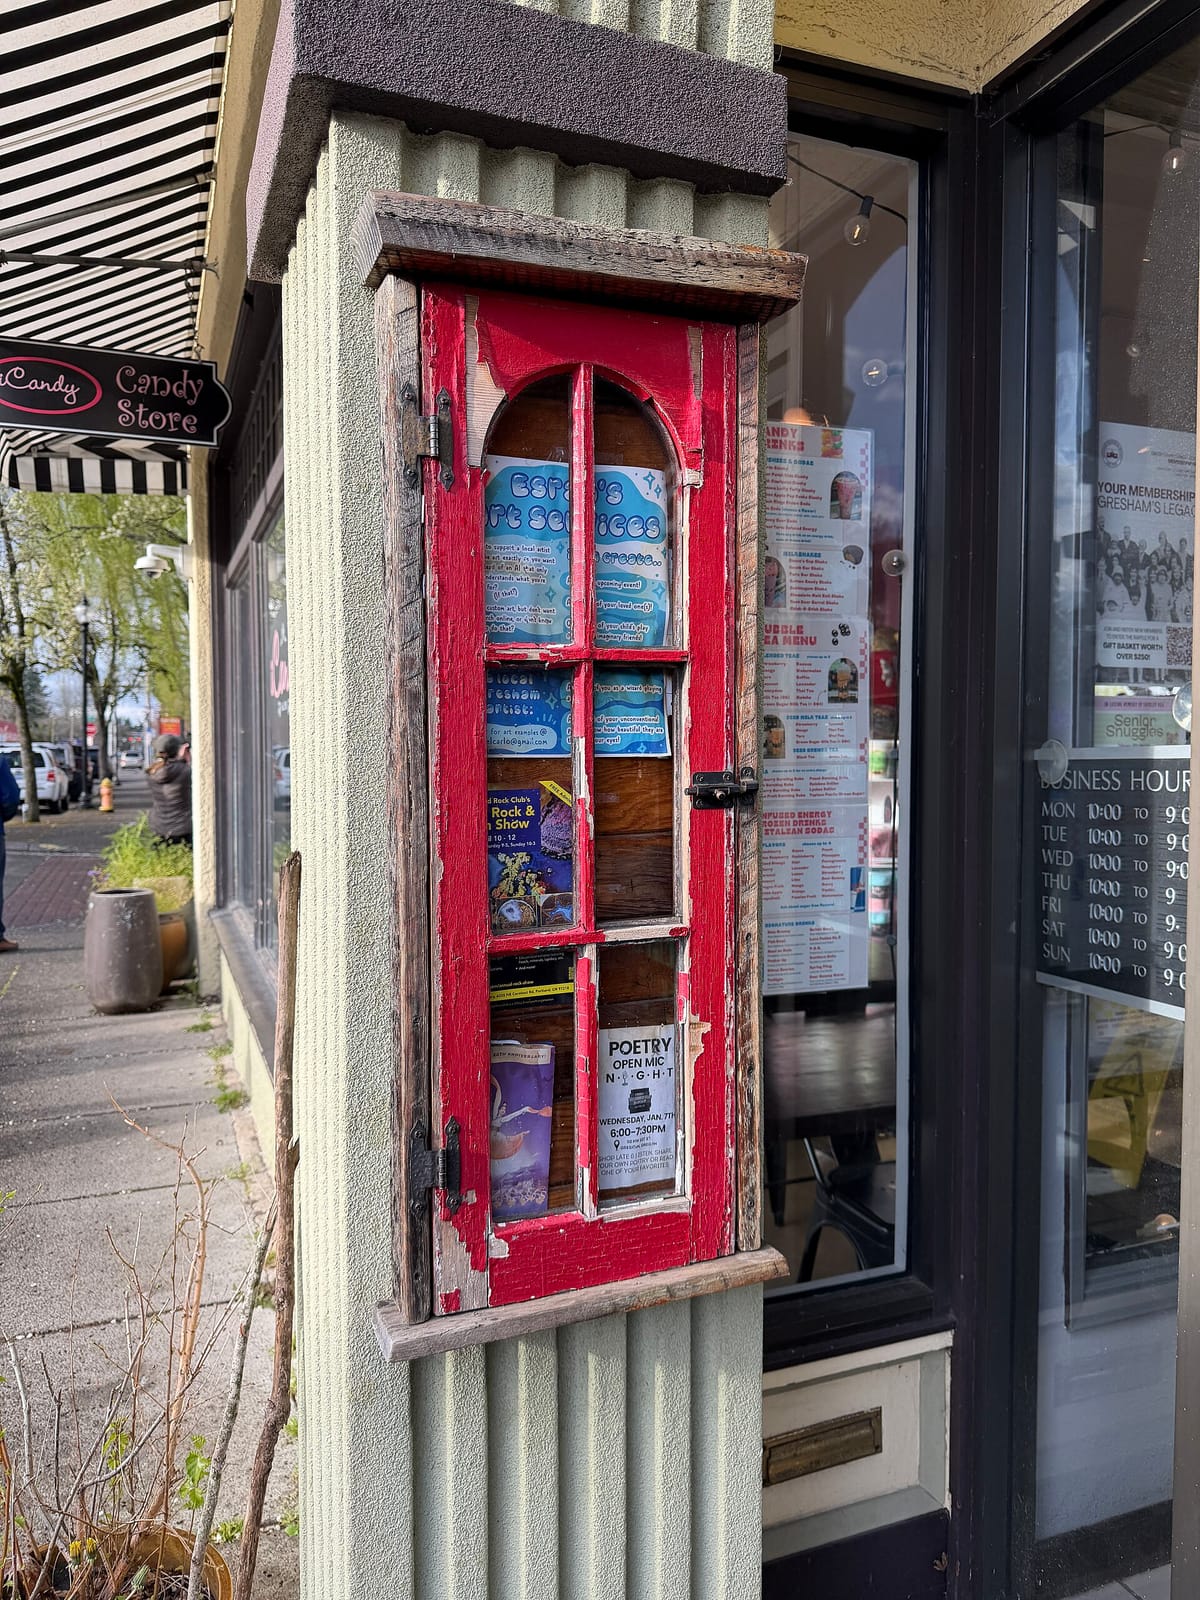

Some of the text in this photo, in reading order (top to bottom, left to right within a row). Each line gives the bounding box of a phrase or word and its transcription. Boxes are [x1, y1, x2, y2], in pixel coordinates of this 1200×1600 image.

[115, 365, 203, 406] Candy
[117, 399, 198, 433] Store
[1098, 481, 1196, 502] YOUR MEMBERSHIP
[1097, 495, 1161, 514] GRESHAM'S
[485, 503, 661, 538] rt Seices
[493, 544, 514, 552] support
[537, 567, 548, 575] only
[487, 583, 498, 591] for?
[597, 581, 622, 589] upcoming
[604, 602, 617, 610] your
[618, 601, 632, 609] loved
[500, 625, 515, 633] that?
[783, 636, 817, 646] MENU
[1141, 643, 1163, 651] WORTH
[497, 673, 533, 685] local
[486, 703, 534, 715] artist:
[1114, 714, 1157, 727] Senior
[1106, 725, 1164, 741] Snuggles
[491, 805, 535, 818] Rock &
[797, 810, 832, 819] ENERGY
[1041, 801, 1076, 819] MON
[1087, 803, 1122, 821] 10:00
[1134, 807, 1149, 820] TO
[495, 819, 530, 830] Show
[764, 827, 803, 836] ITALIAN
[1041, 825, 1068, 842] TUE
[1087, 828, 1122, 846] 10:00
[1134, 833, 1149, 846] TO
[1041, 849, 1074, 867] WED
[1088, 853, 1122, 872] 10:00
[1133, 859, 1149, 872] TO
[1041, 872, 1071, 891] THU
[1088, 877, 1121, 898] 10:00
[1133, 885, 1148, 899] TO
[1041, 896, 1148, 925] FRI 10:00 TO
[1042, 919, 1066, 938] SAT
[1088, 927, 1121, 949] 10:00
[1132, 937, 1147, 951] TO
[1042, 943, 1071, 963] SUN
[1088, 952, 1121, 975] 10:00
[1132, 964, 1147, 978] TO
[609, 1037, 672, 1056] POETRY
[613, 1056, 664, 1070] OPEN MIC
[599, 1115, 646, 1126] WEDNESDAY,
[614, 1160, 629, 1168] OWN
